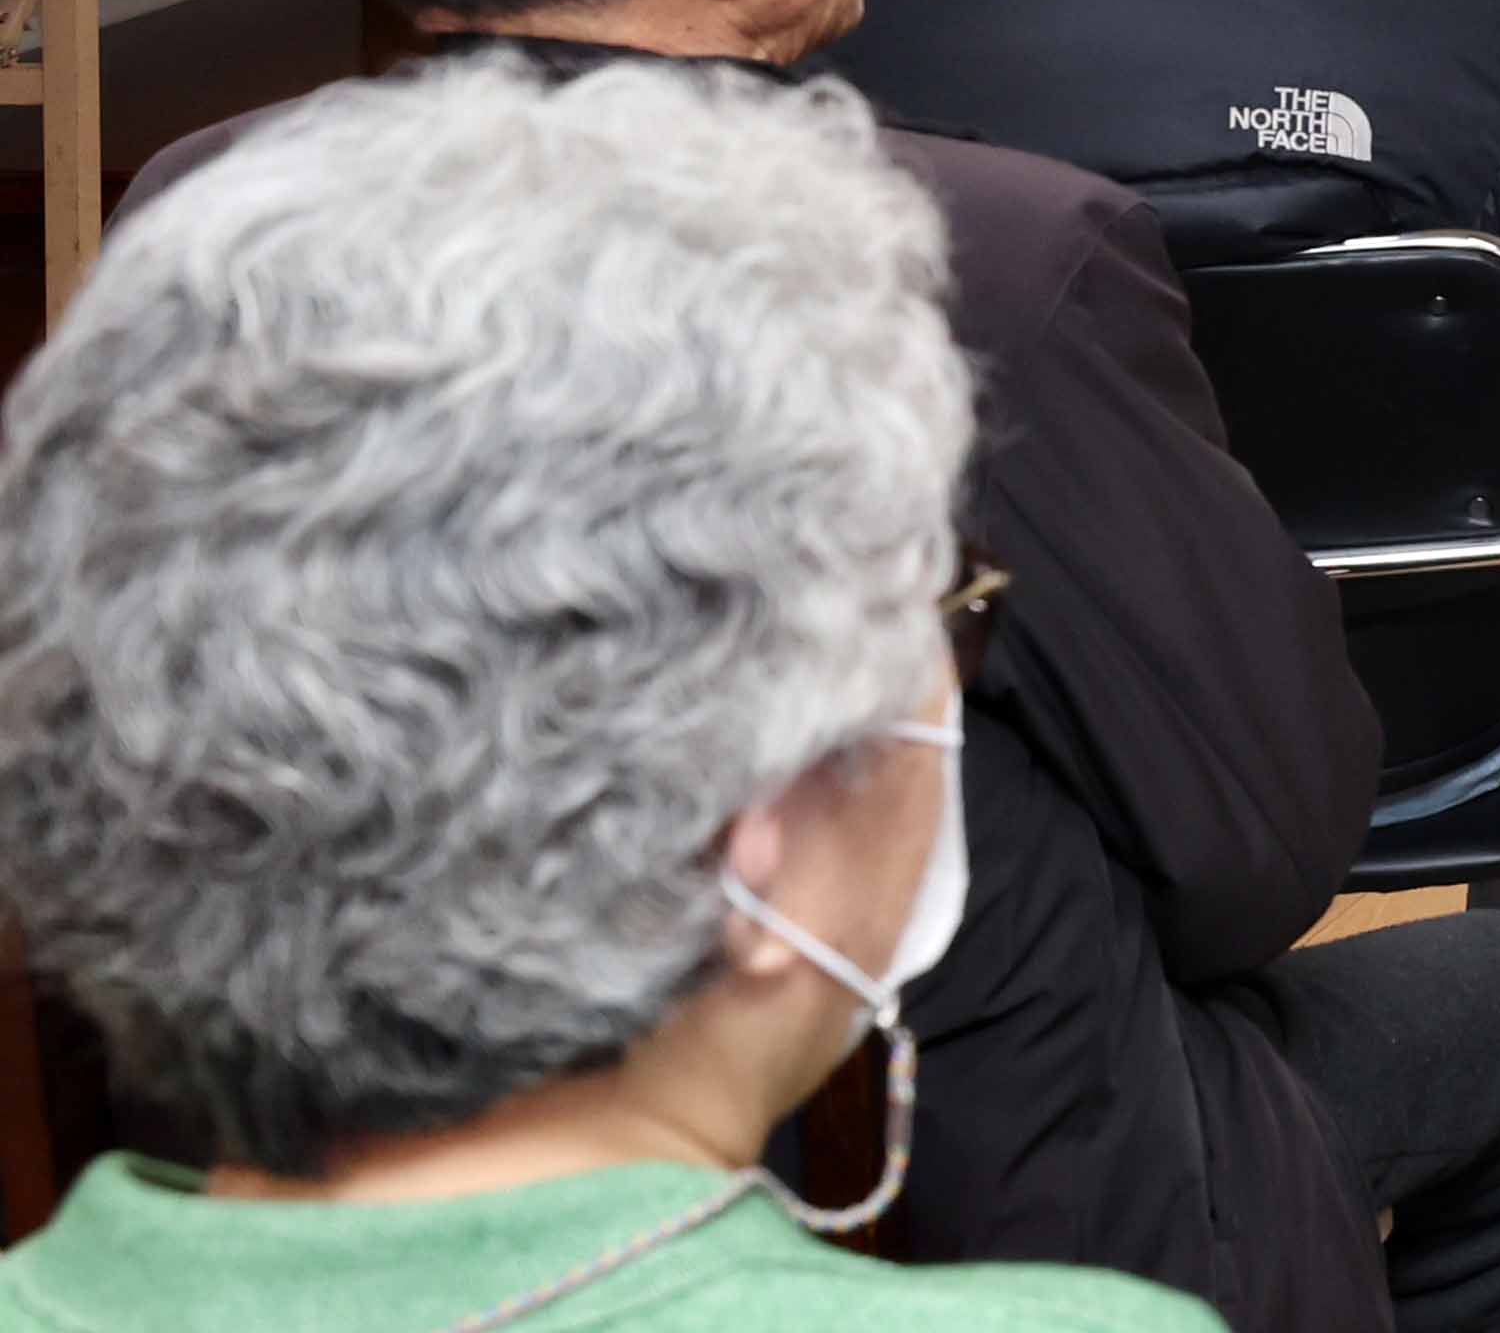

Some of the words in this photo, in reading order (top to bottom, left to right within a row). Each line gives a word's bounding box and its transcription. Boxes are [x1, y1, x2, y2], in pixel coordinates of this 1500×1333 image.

[1274, 86, 1330, 112] THE
[1229, 106, 1328, 134] NORTH
[1258, 130, 1328, 154] FACE
